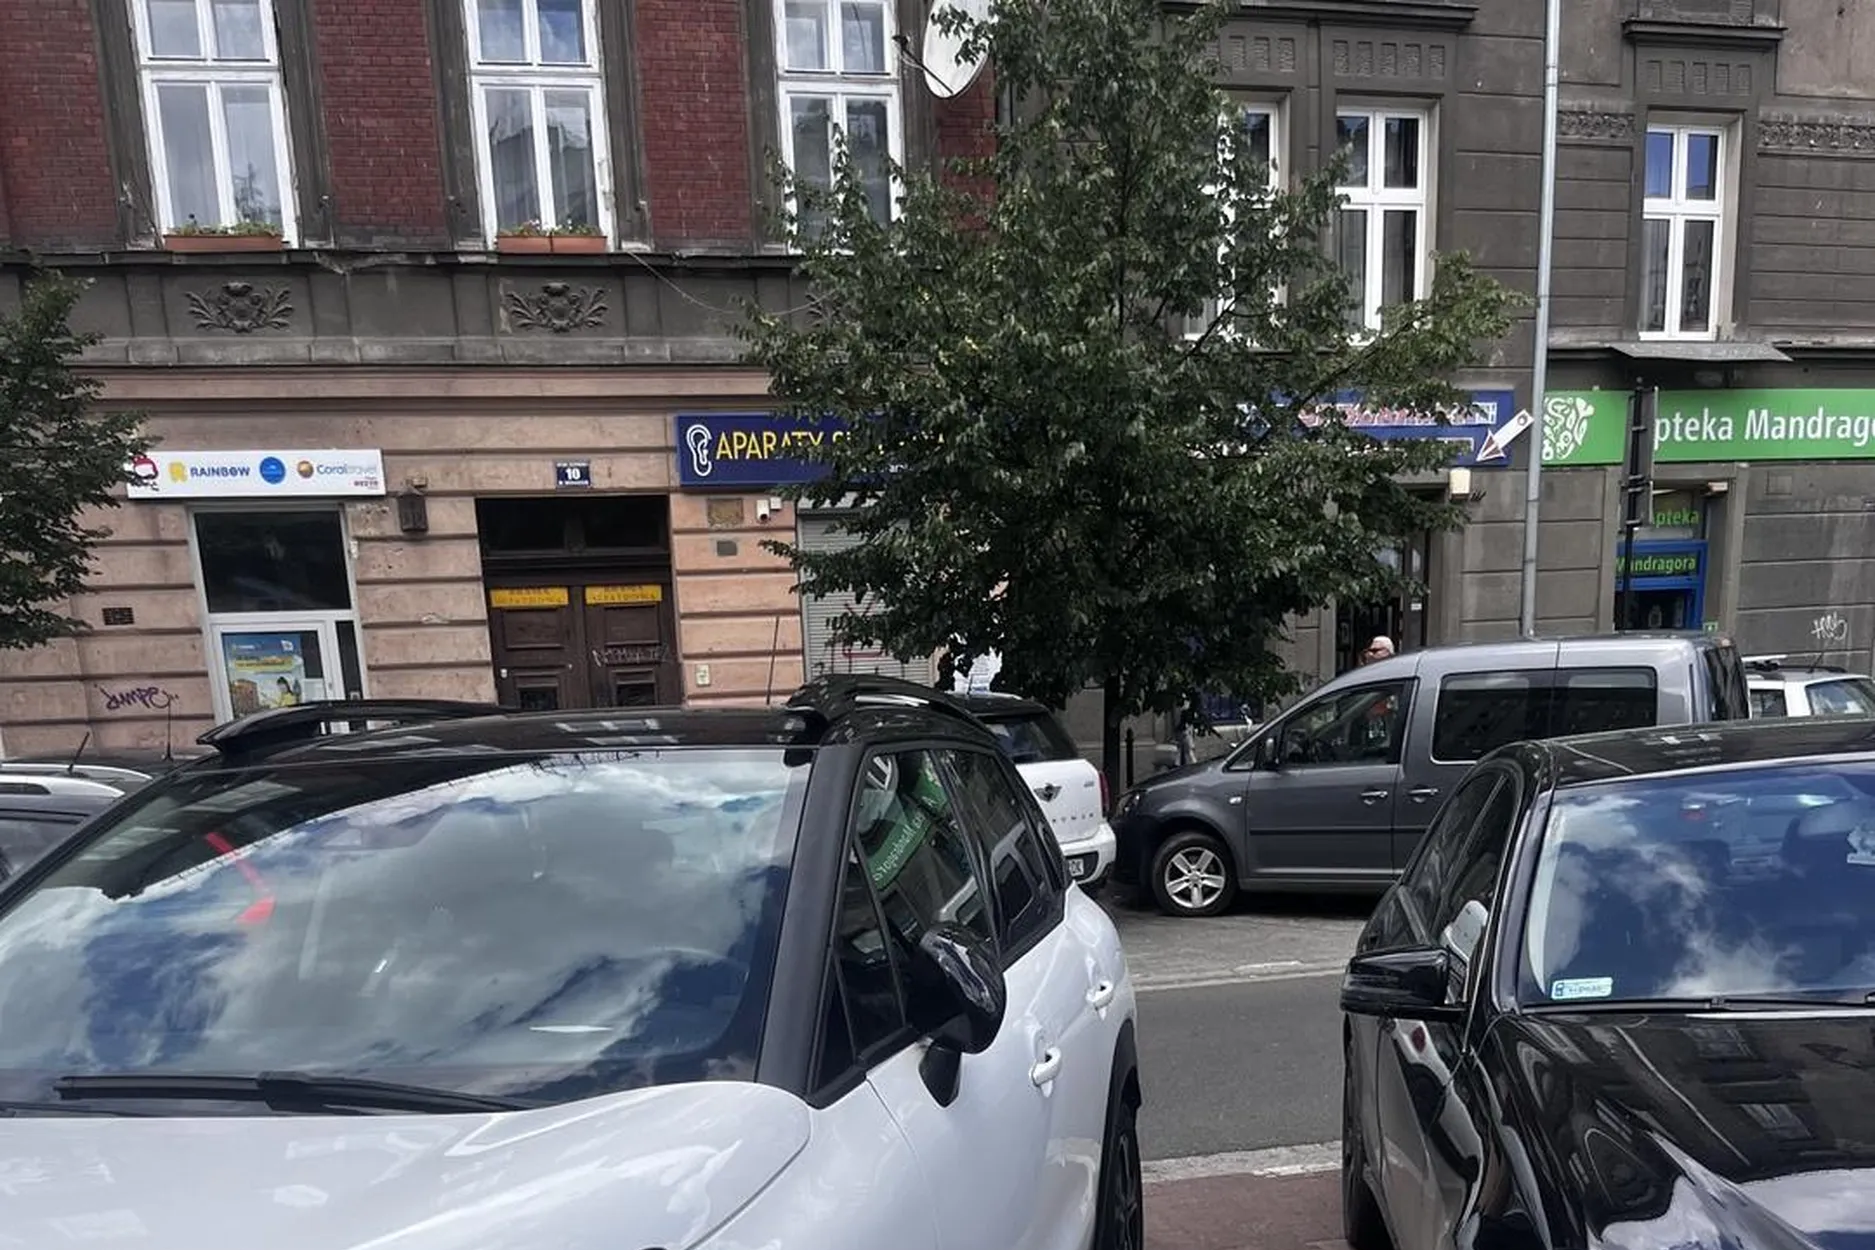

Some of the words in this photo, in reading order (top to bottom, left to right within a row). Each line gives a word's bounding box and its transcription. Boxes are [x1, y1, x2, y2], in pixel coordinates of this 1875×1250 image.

[1653, 408, 1733, 451] pteka
[190, 466, 250, 477] RAINBOW
[565, 467, 581, 480] 10
[1652, 507, 1700, 529] pteka
